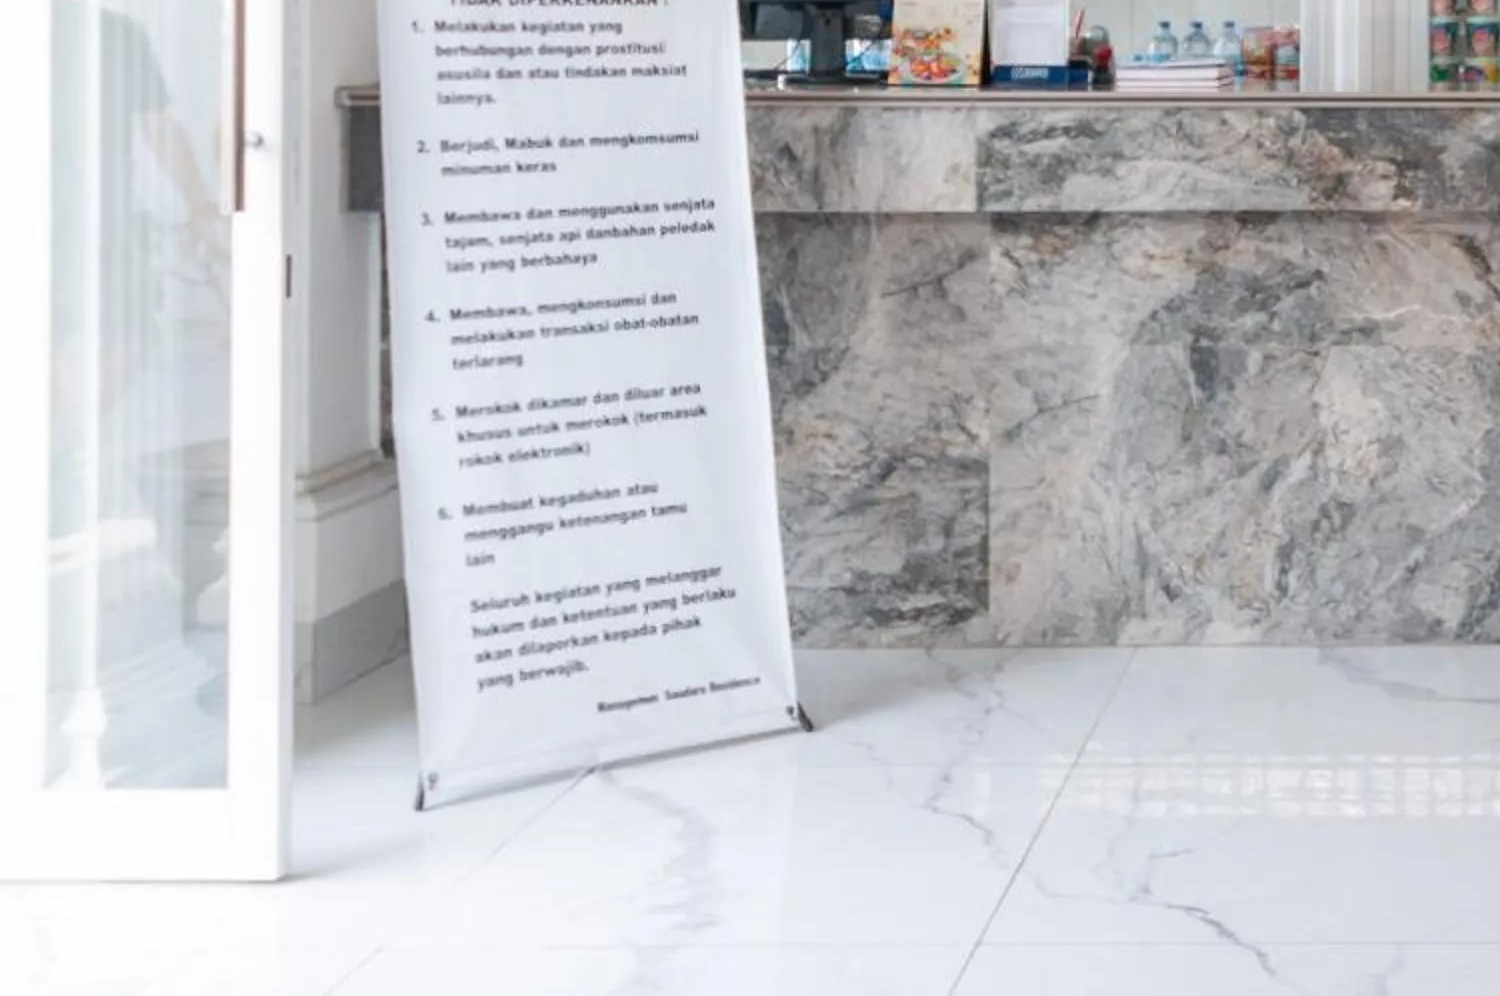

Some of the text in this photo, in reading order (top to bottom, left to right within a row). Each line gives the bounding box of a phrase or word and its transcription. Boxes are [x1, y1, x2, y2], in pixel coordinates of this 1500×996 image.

[435, 20, 516, 33] Melakukan
[521, 21, 584, 36] kegiatan
[589, 22, 623, 35] yang
[436, 45, 533, 59] berhubungan
[537, 44, 591, 58] dengan
[496, 68, 523, 79] dan
[528, 68, 560, 79] atau
[564, 66, 627, 78] tindakan
[631, 64, 687, 77] maksiat
[418, 140, 430, 153] 2.
[505, 136, 553, 150] Mabuk
[558, 136, 585, 148] dan
[442, 161, 557, 176] minuman keras
[445, 211, 521, 224] Membawa
[526, 208, 553, 220] dan
[559, 202, 659, 219] menggunakan
[664, 198, 715, 214] senjata
[500, 232, 554, 247] senjata
[559, 230, 581, 243] api
[660, 220, 715, 237] peledak
[447, 253, 598, 274] lain yang berbahaya
[426, 310, 440, 322] 4.
[538, 294, 646, 315] mengkonsumsi
[650, 292, 677, 305] dan
[452, 314, 699, 345] melakukan transaksi obat-obatan
[453, 354, 524, 370] terlarang
[456, 401, 522, 418] Merokok
[527, 396, 587, 411] dikamar
[592, 392, 620, 405] dan
[624, 388, 665, 401] diluar
[670, 384, 701, 396] area
[458, 405, 707, 443] khusus untuk merokok (termasuk
[460, 442, 590, 467] rokok elektronik)
[463, 497, 534, 517] Membuat
[540, 489, 621, 508] kegaduhan
[628, 484, 658, 496] atau
[559, 509, 647, 529] ketenangan
[651, 504, 687, 516] tamu
[467, 554, 495, 566] lain
[471, 566, 722, 613] Seluruh kegiatan yang melanggar
[473, 588, 736, 638] hukum dan ketentuan yang berlaku
[476, 616, 701, 663] akan dilaporkan kepada pihak
[478, 674, 514, 692] yang
